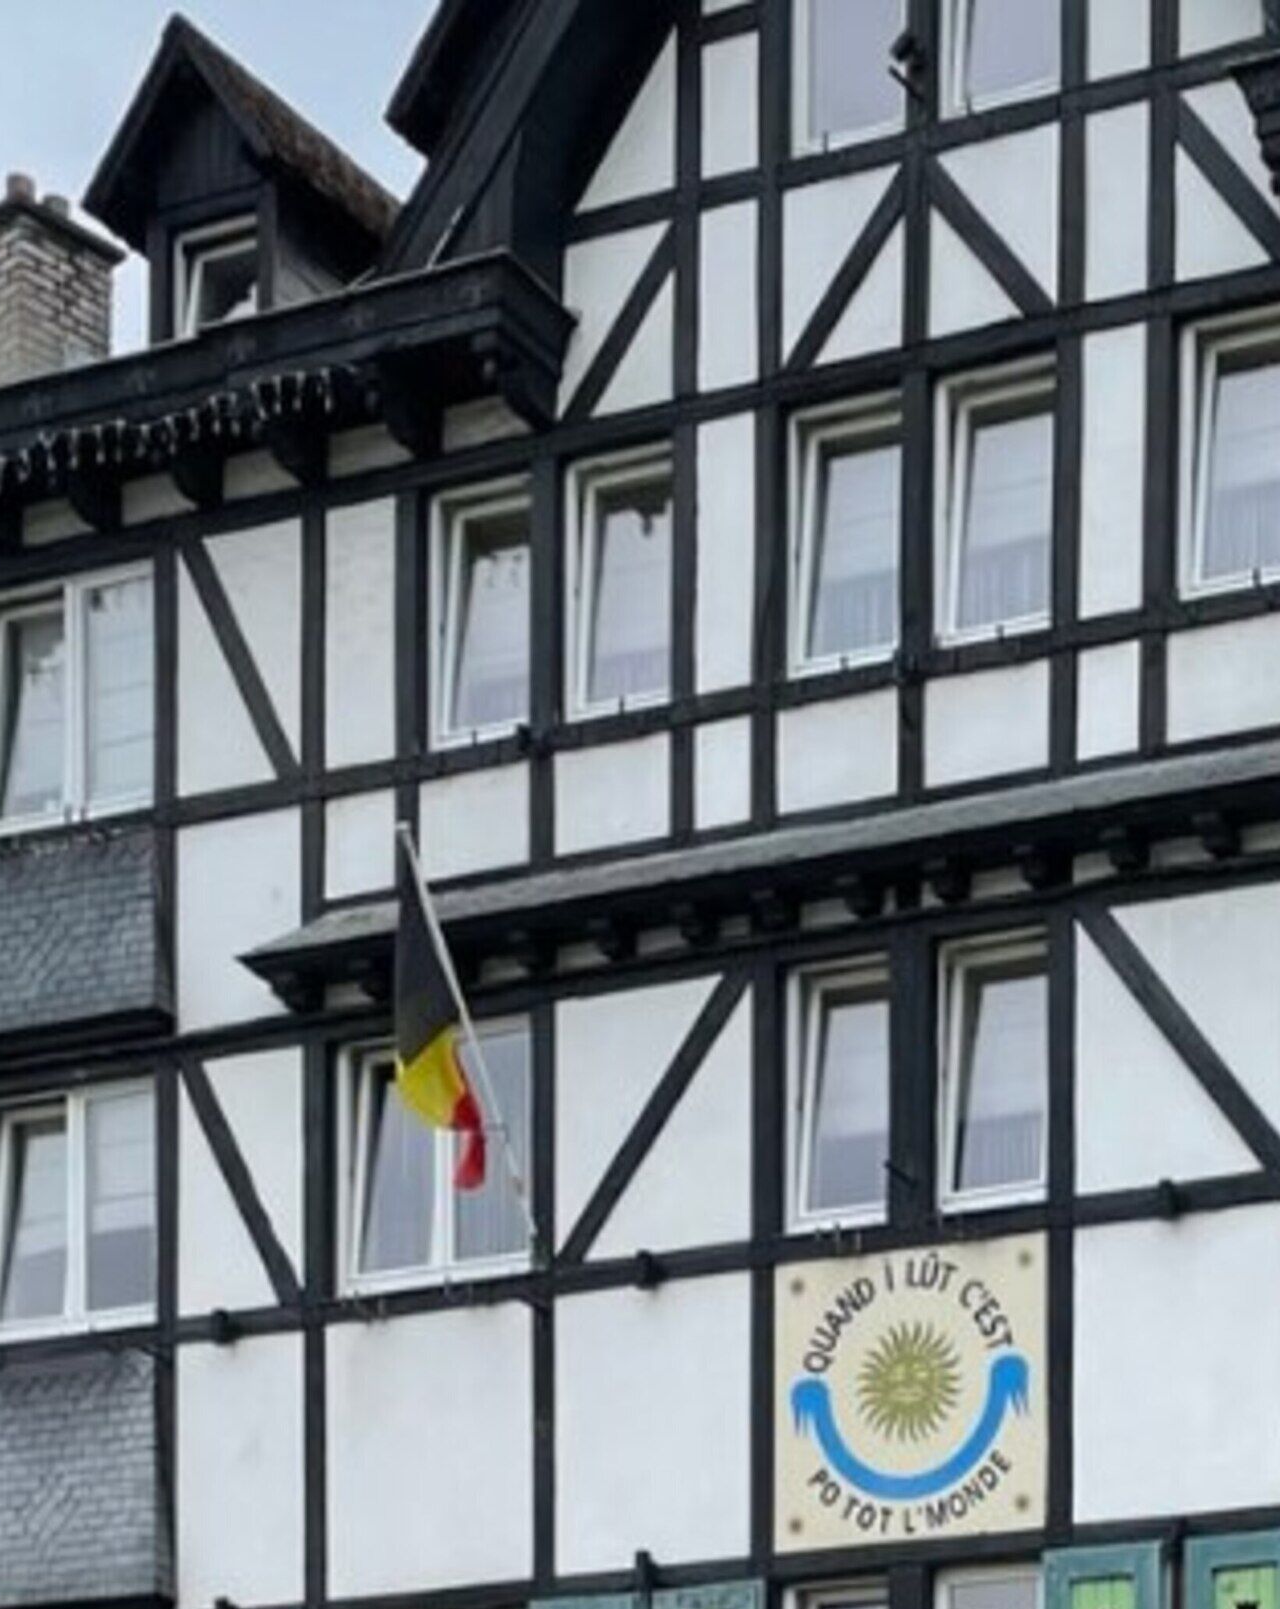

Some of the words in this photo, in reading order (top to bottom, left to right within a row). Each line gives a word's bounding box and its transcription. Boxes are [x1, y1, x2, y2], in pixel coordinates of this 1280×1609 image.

[803, 1277, 875, 1373] QUAND
[959, 1280, 1012, 1349] C'EST
[807, 1468, 841, 1506] PO
[904, 1450, 1012, 1533] L'MONDE
